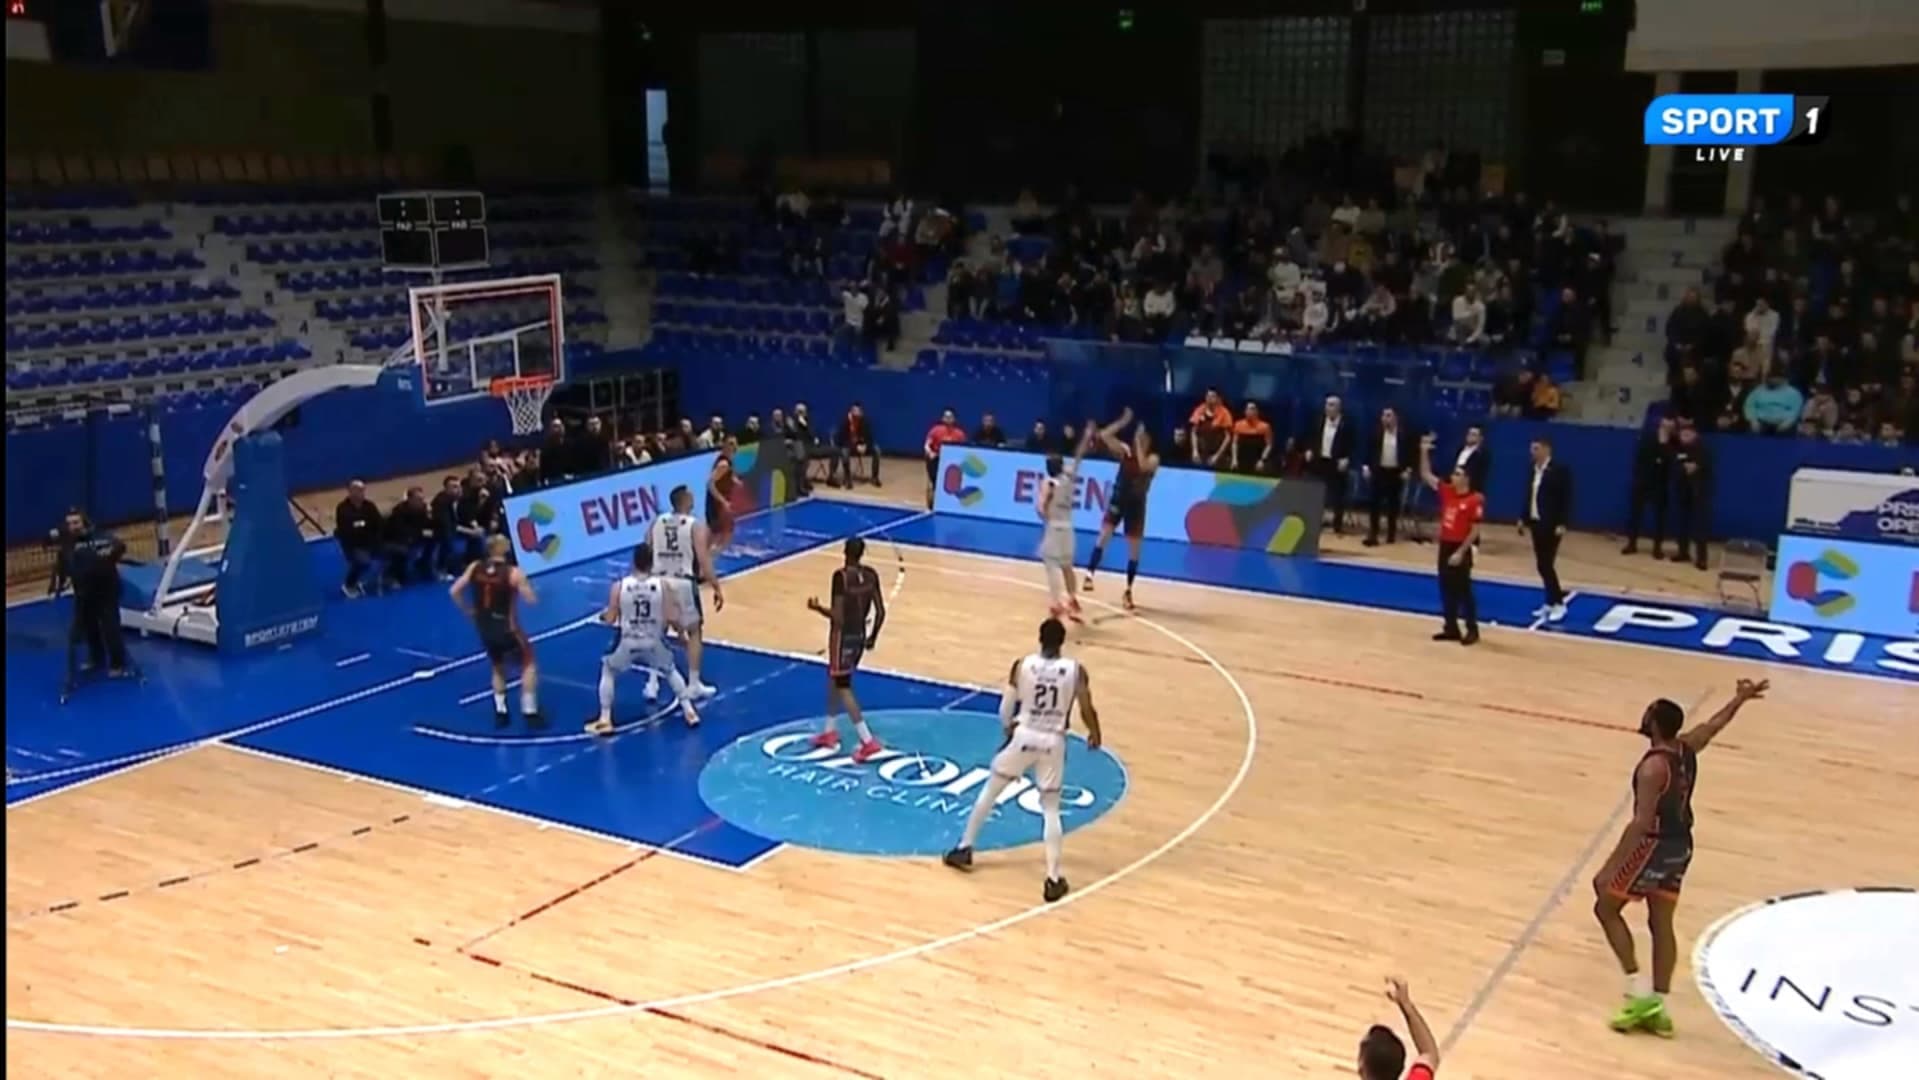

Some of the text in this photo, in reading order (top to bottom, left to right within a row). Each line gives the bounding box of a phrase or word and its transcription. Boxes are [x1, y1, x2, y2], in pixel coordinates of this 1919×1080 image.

[1014, 469, 1112, 512] EEN
[580, 485, 661, 536] EVEN
[665, 530, 679, 551] 12
[633, 600, 650, 618] 13
[1034, 684, 1058, 709] 21
[767, 764, 860, 791] HAIR
[1740, 968, 1919, 1027] INS
